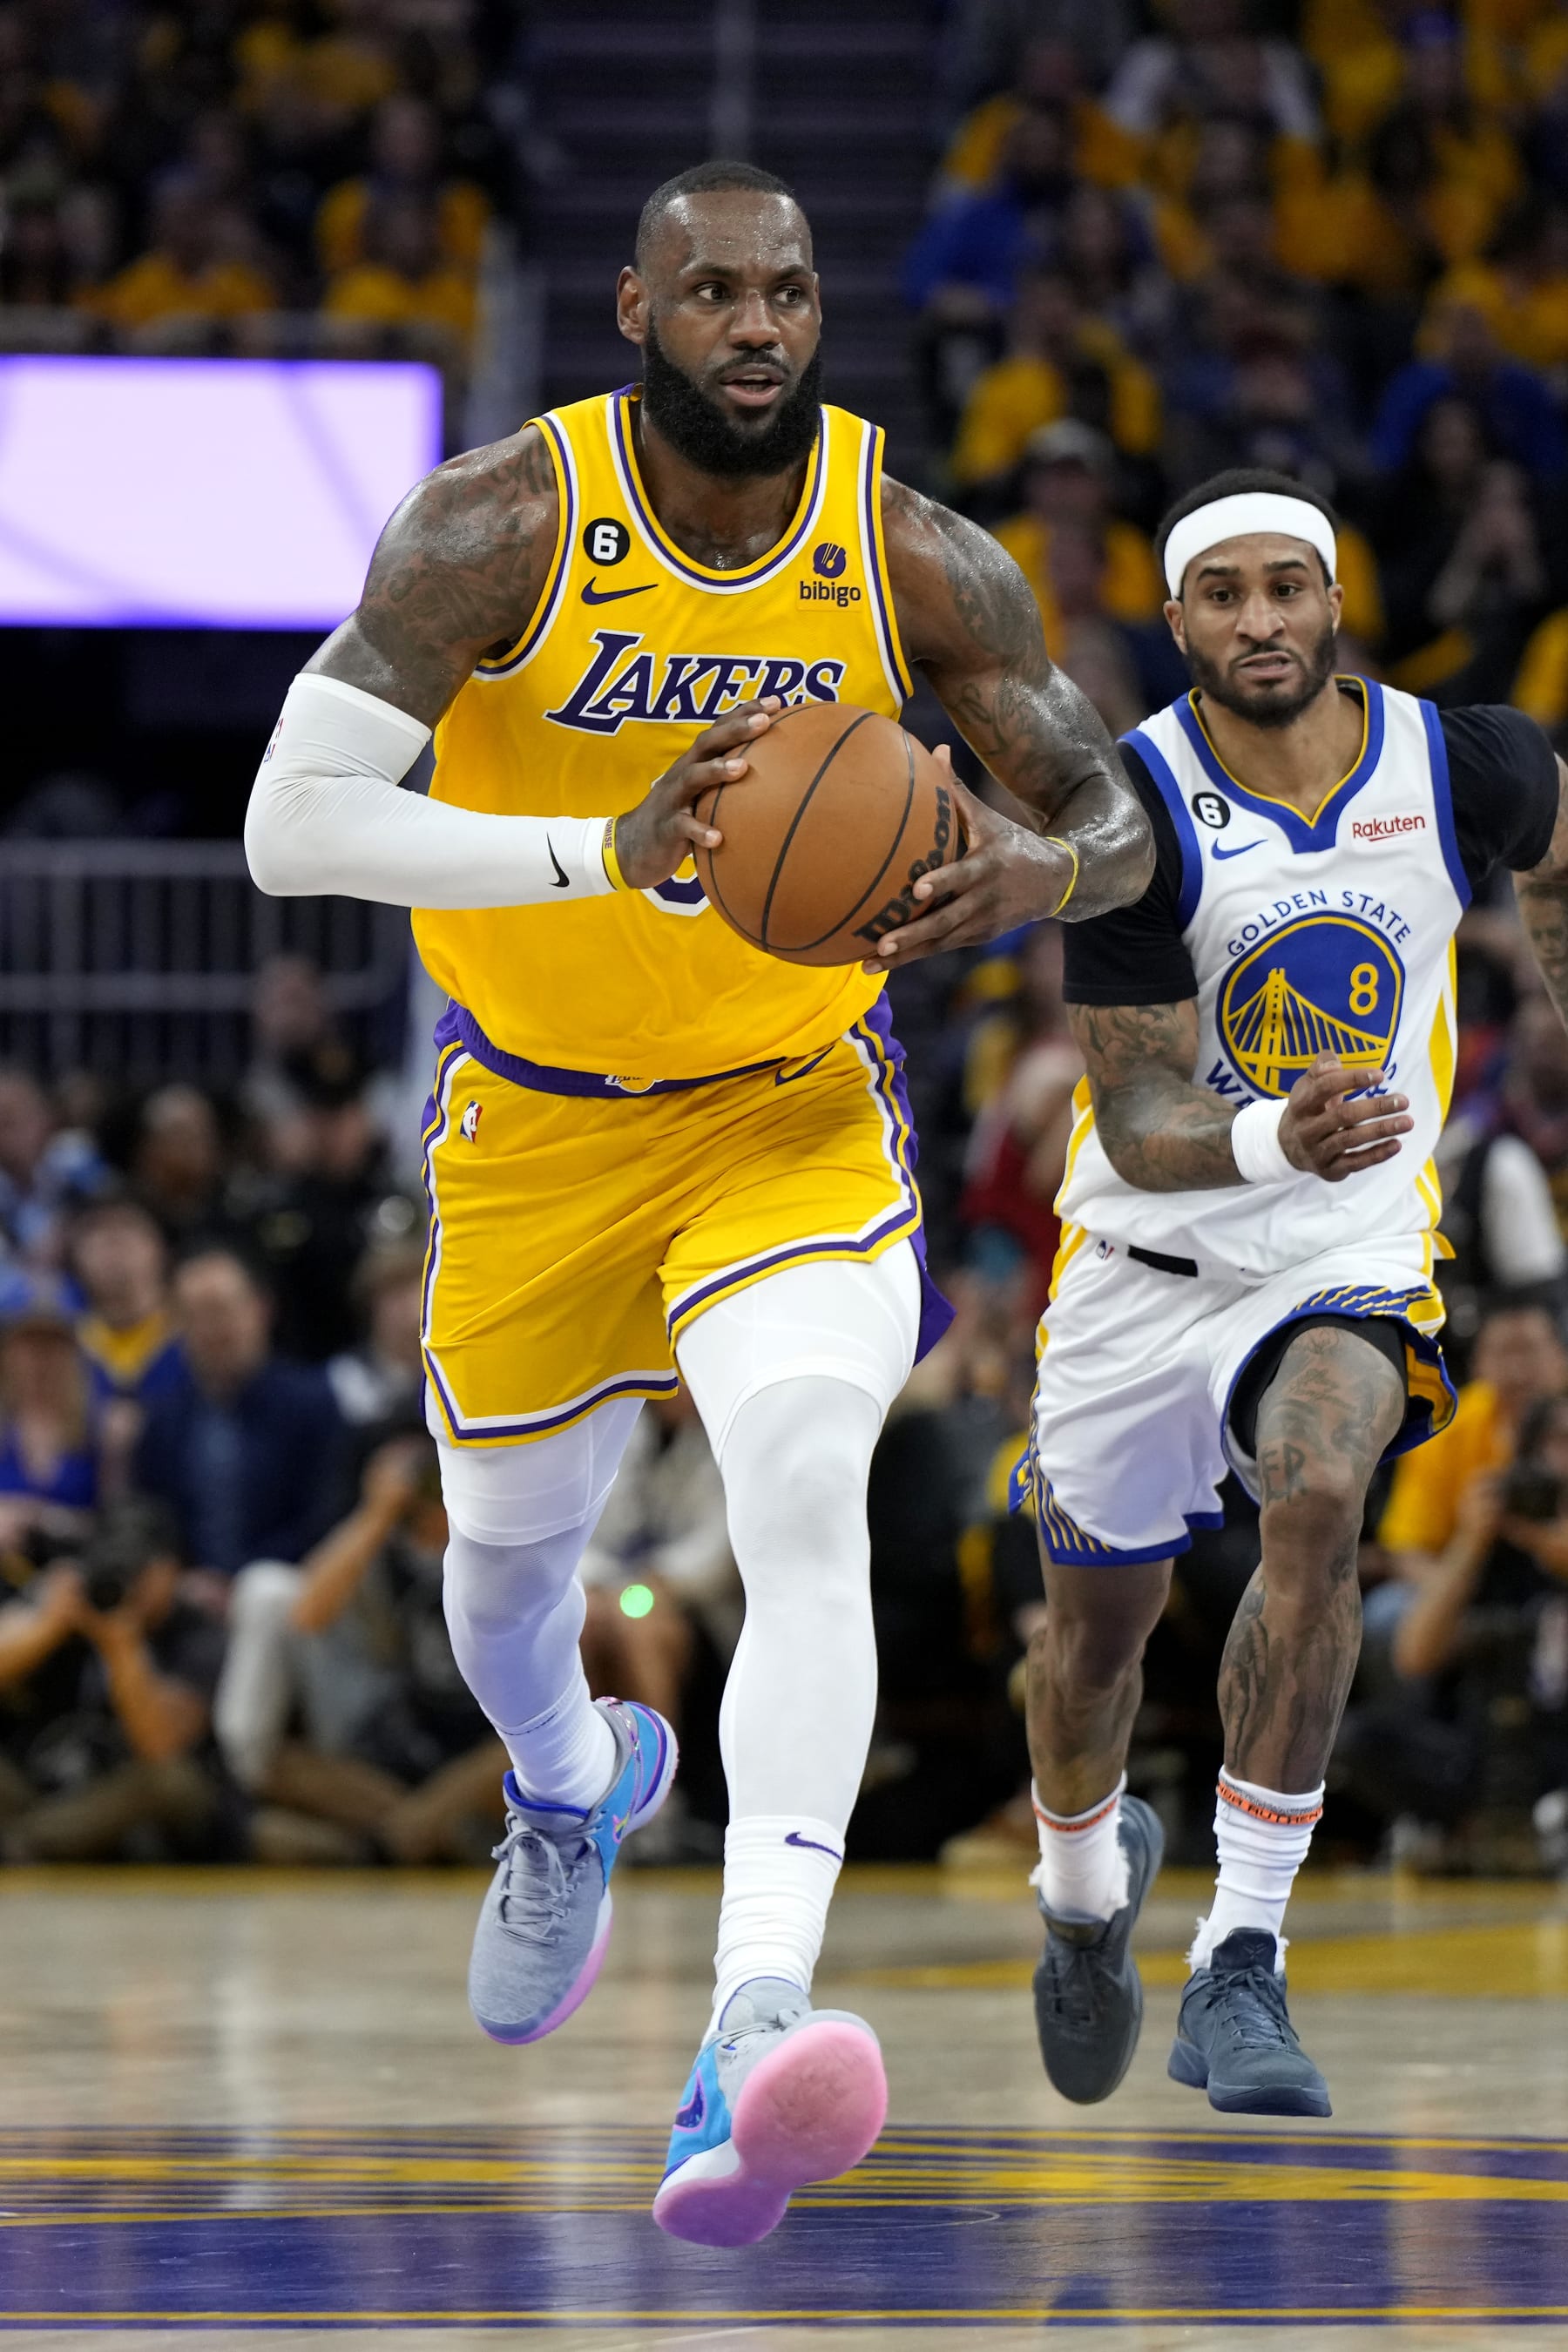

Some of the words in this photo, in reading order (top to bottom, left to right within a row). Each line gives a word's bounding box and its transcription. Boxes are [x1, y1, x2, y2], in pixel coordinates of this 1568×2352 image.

[592, 524, 619, 561] 6
[799, 580, 862, 608] bibigo
[543, 629, 847, 735] LAKERS
[1197, 796, 1223, 827] 6
[1352, 814, 1426, 840] Rakuten
[1227, 889, 1328, 956] GOLDEN
[1342, 890, 1412, 944] STATE
[1348, 963, 1379, 1017] 8
